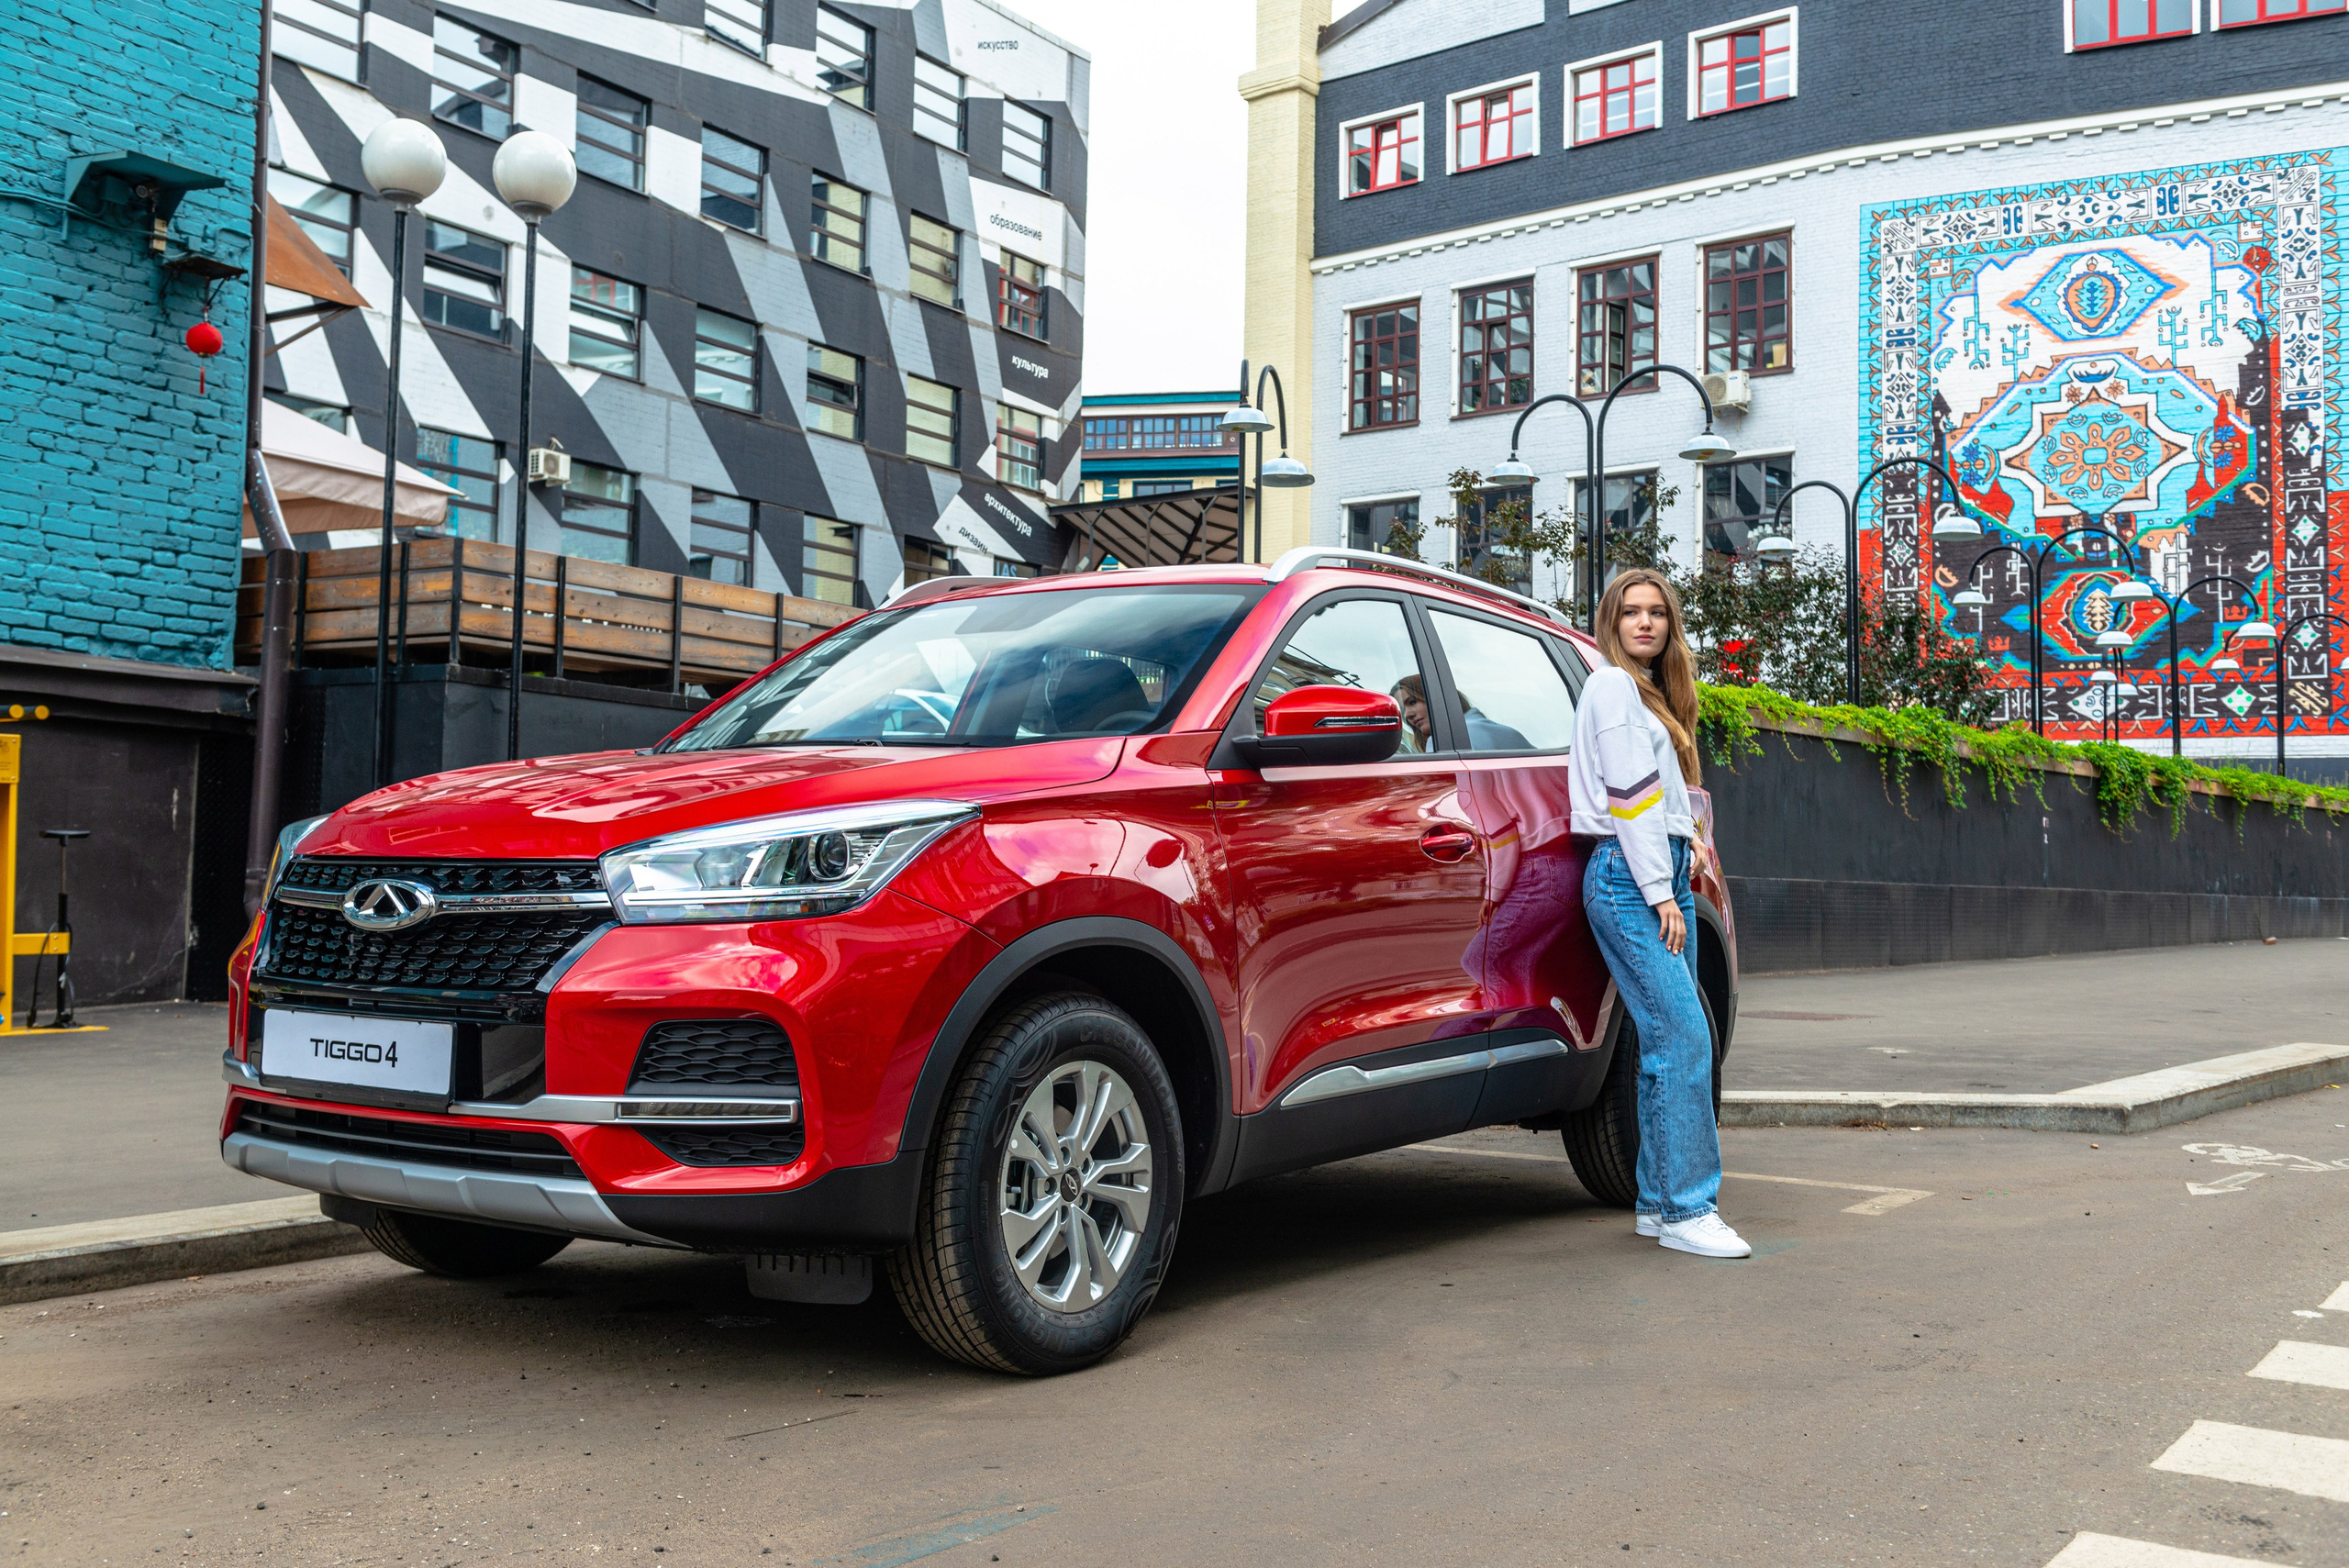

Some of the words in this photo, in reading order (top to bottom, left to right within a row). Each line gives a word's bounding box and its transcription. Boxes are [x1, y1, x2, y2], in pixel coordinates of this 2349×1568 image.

[977, 40, 1019, 52] искусство
[990, 214, 1042, 240] образование
[1011, 355, 1049, 378] культура
[984, 493, 1032, 538] архитектура
